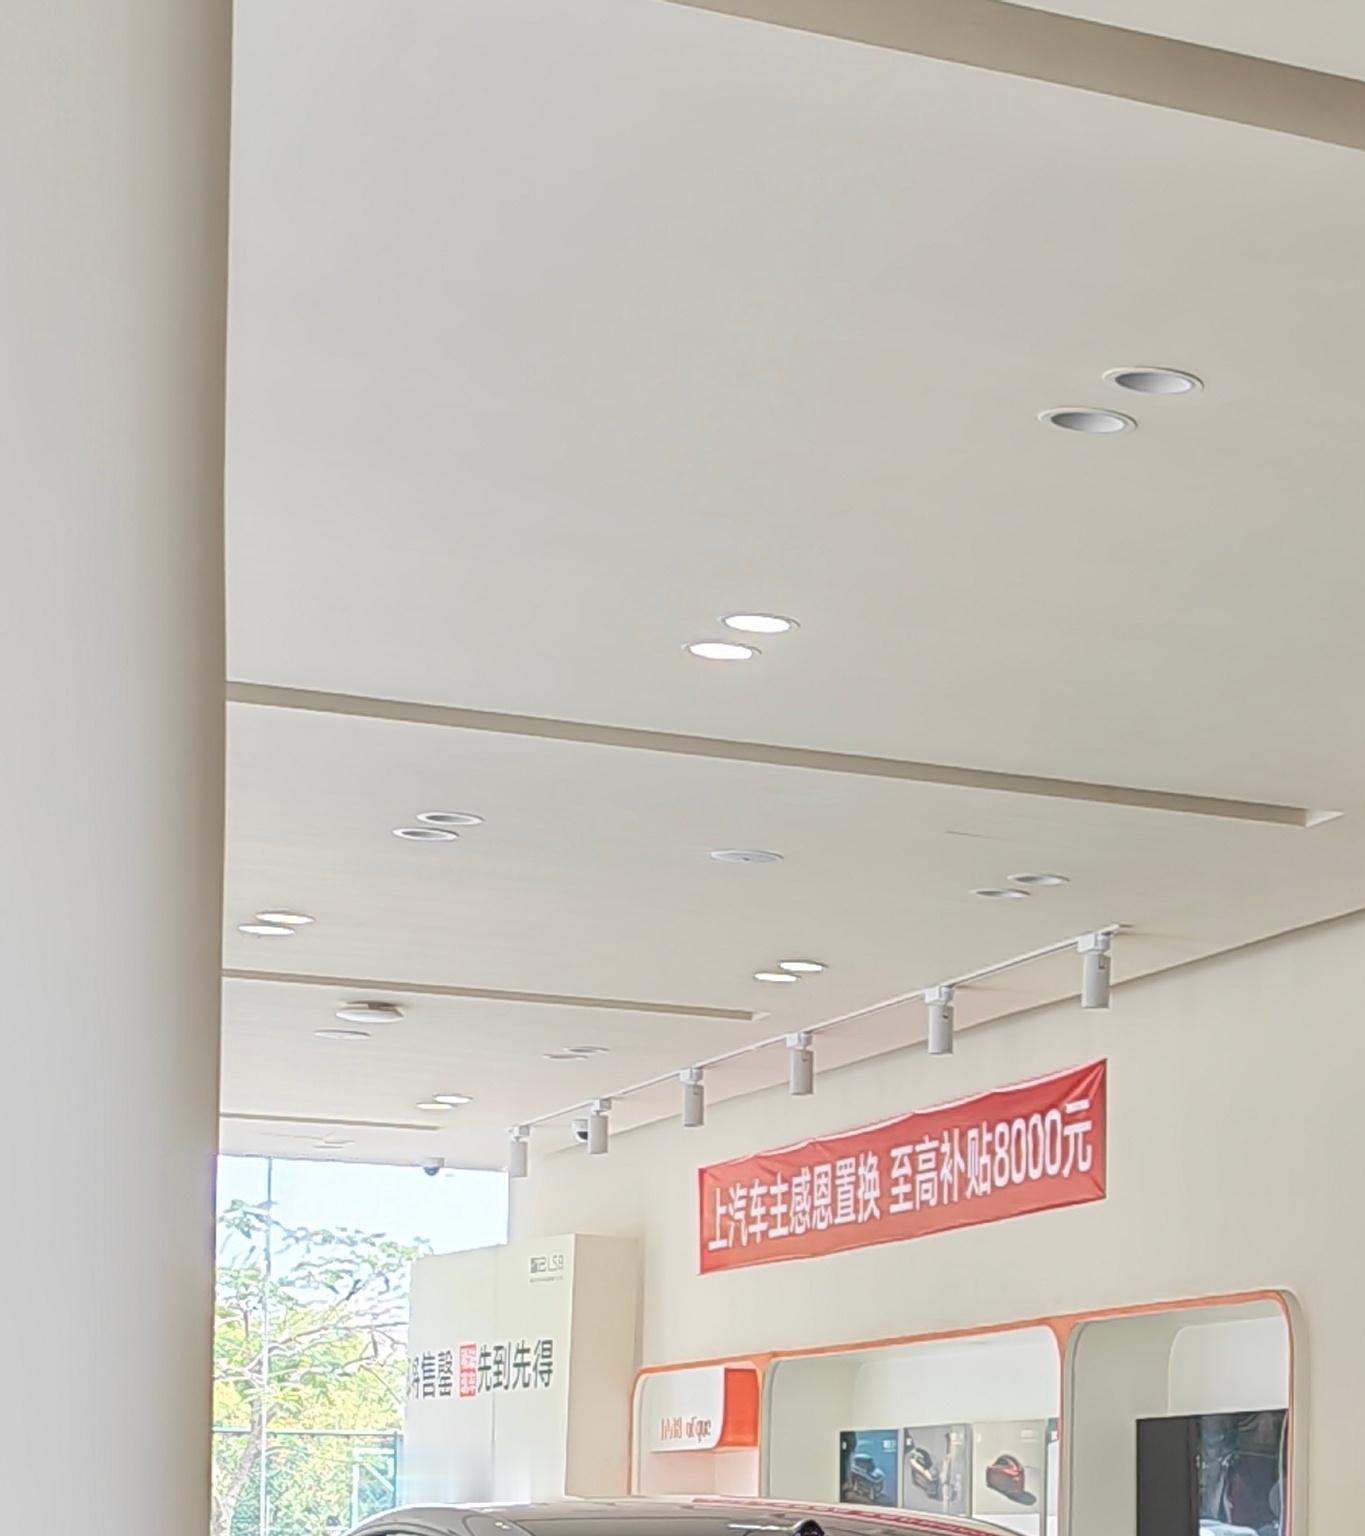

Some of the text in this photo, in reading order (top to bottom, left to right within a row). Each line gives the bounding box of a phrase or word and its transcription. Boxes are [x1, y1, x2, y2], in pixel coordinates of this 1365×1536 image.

[707, 1098, 1093, 1252] 上汽车主感恩置换 至高补贴8000元
